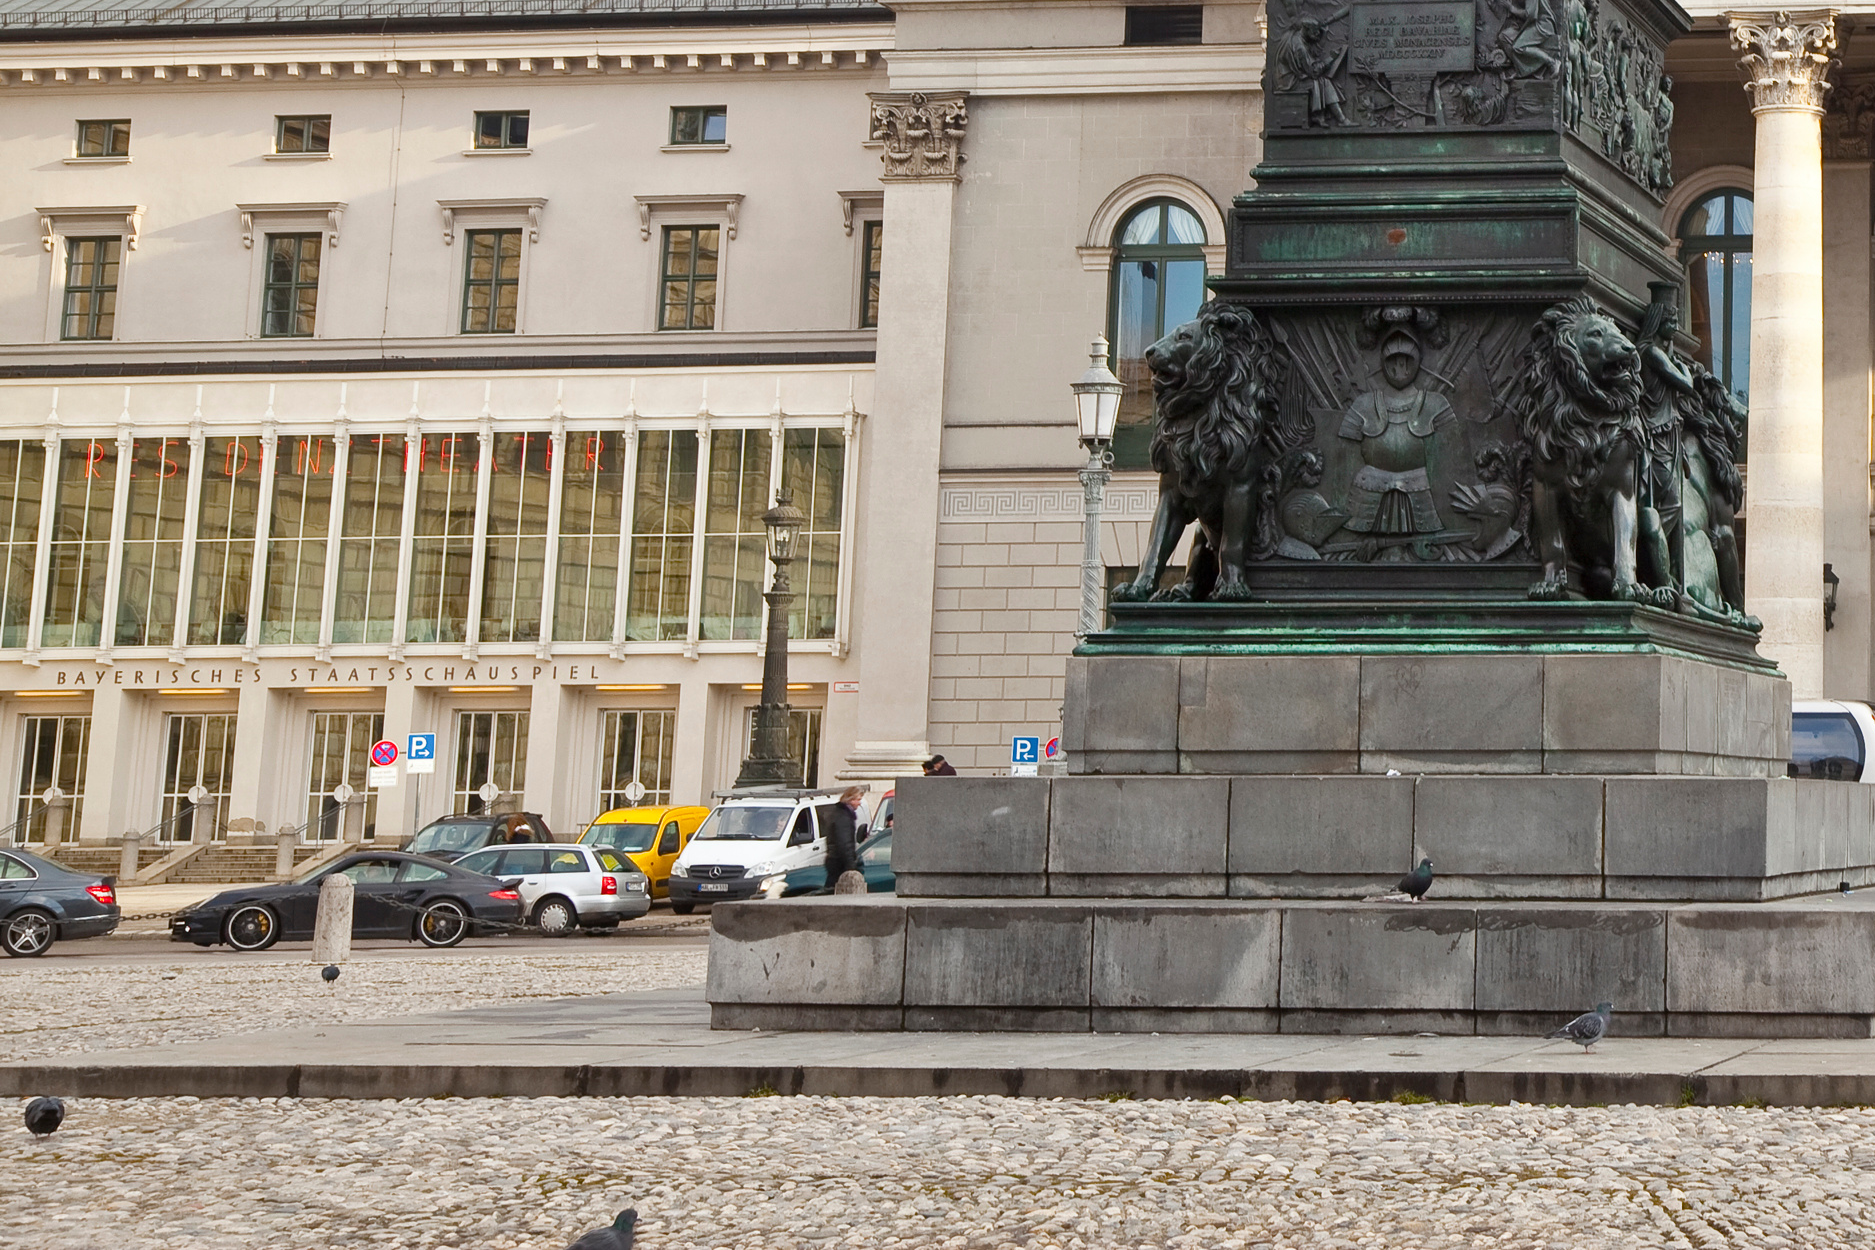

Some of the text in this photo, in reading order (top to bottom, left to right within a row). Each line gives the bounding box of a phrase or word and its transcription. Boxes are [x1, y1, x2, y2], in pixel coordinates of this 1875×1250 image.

[57, 666, 599, 685] BAYERISCHES STAATSSCHAUSPIEL
[411, 737, 427, 757] P
[1016, 739, 1031, 760] P
